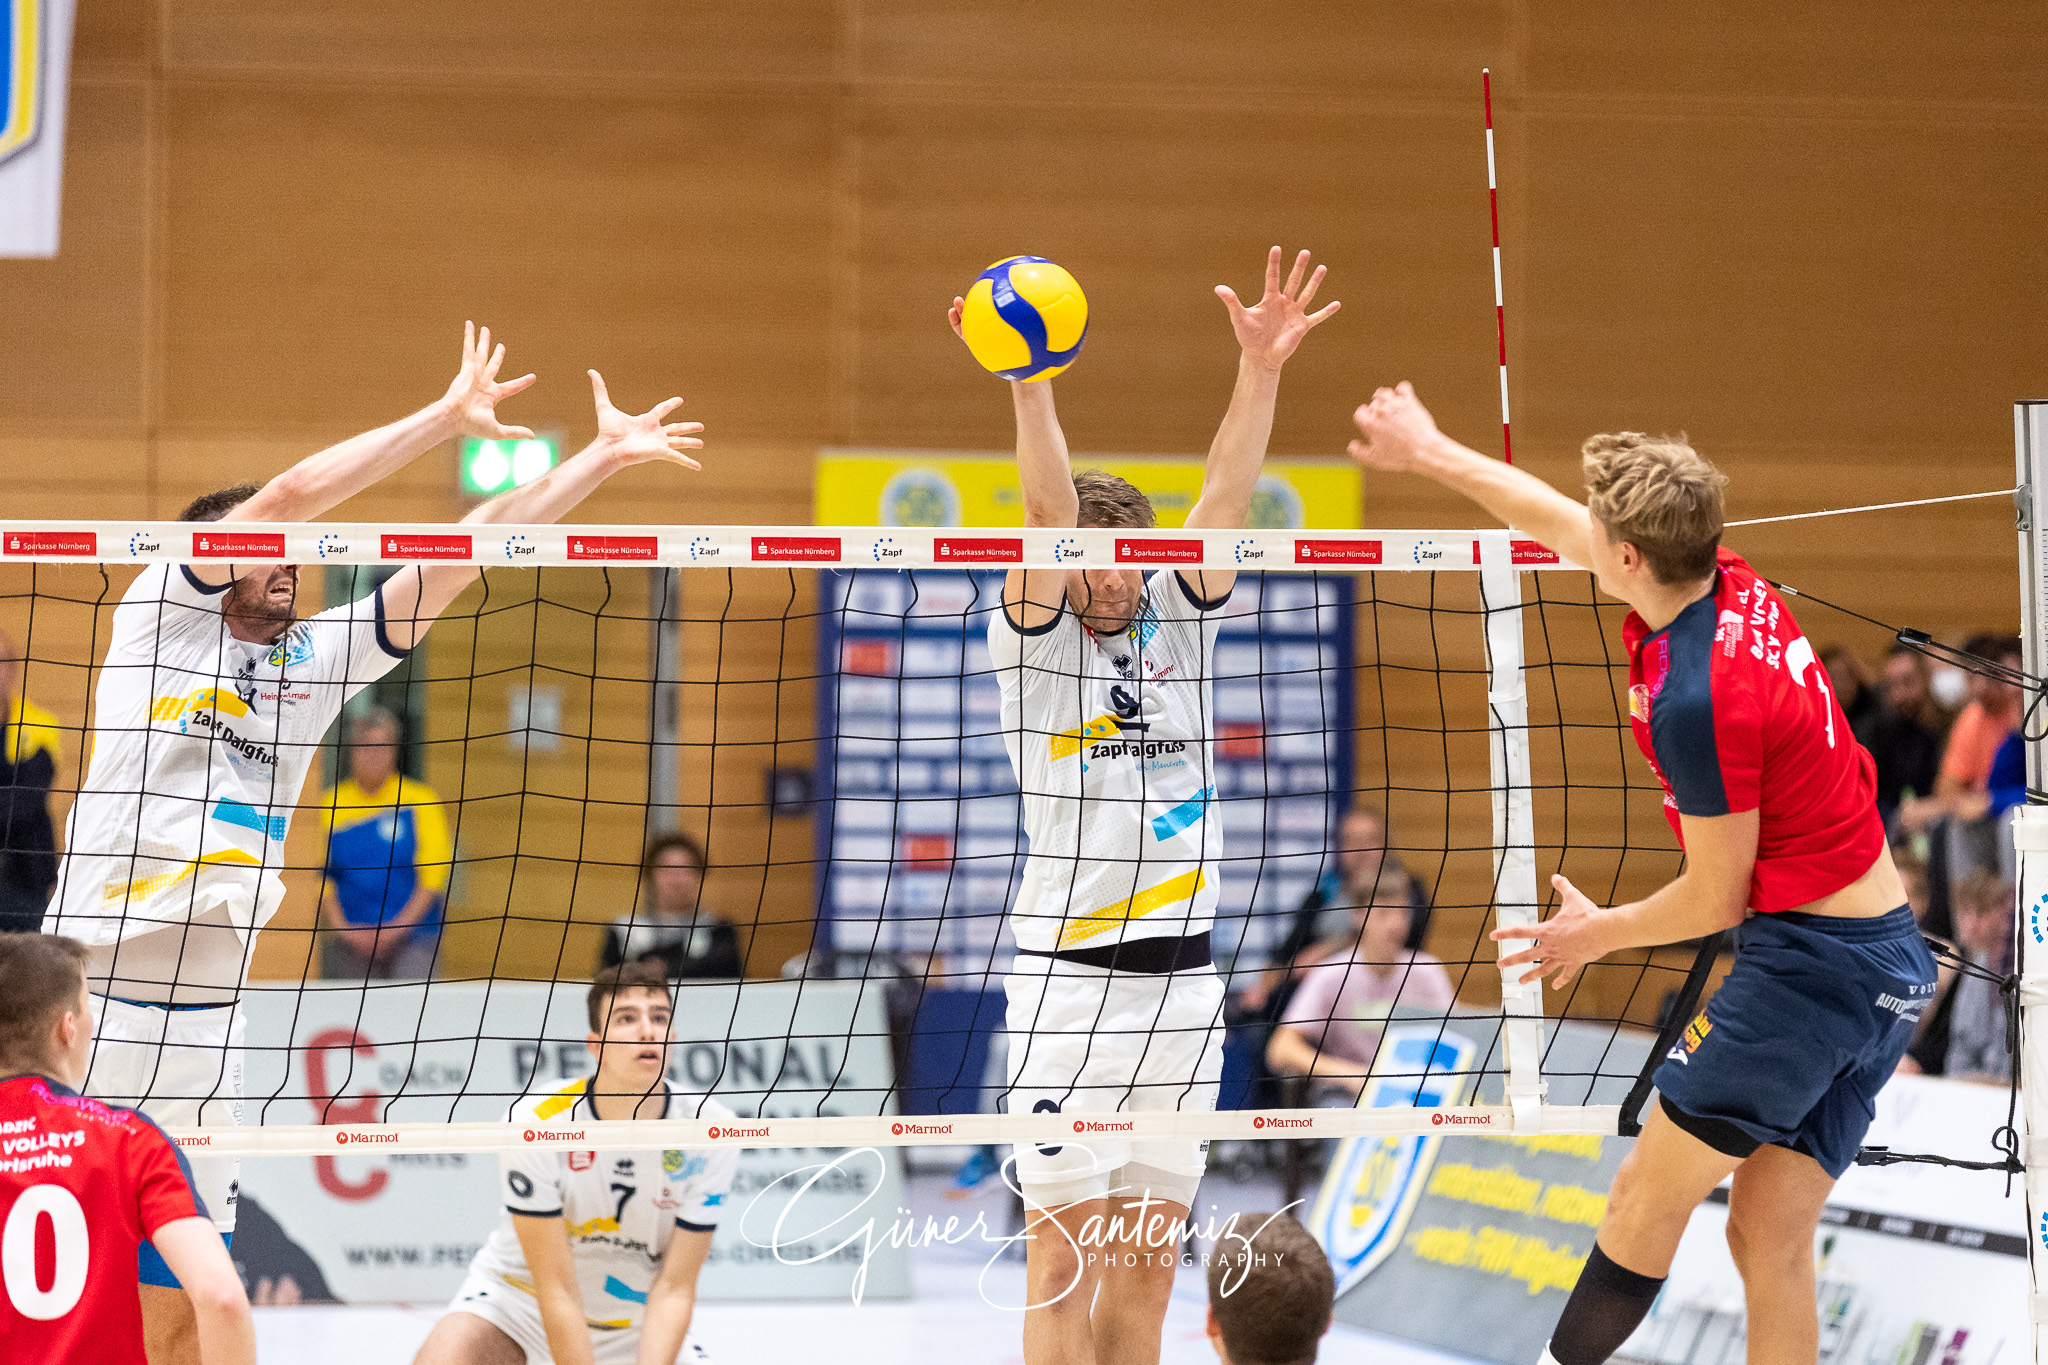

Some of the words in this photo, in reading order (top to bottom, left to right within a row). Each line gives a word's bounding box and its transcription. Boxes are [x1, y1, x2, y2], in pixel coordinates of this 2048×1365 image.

[24, 542, 56, 552] Sparkasse
[58, 542, 90, 552] Nürnberg
[138, 543, 160, 552] Zapf
[212, 543, 246, 553] Sparkasse
[248, 543, 279, 553] Nürnberg
[327, 545, 348, 554] Zapf
[400, 545, 433, 555] Sparkasse
[435, 545, 466, 555] Nürnberg
[514, 546, 535, 555] Zapf
[586, 546, 618, 556] Sparkasse
[620, 546, 651, 556] Nürnberg
[699, 547, 720, 556] Zapf
[771, 547, 803, 557] Sparkasse
[805, 547, 835, 557] Nürnberg
[881, 549, 902, 557] Zapf
[953, 548, 984, 558] Sparkasse
[986, 548, 1016, 558] Nürnberg
[1063, 550, 1084, 558] Zapf
[1134, 549, 1165, 559] Sparkasse
[1167, 549, 1197, 559] Nürnberg
[1243, 550, 1264, 559] Zapf
[1313, 550, 1345, 560] Sparkasse
[1347, 550, 1376, 560] Nürnberg
[1422, 551, 1442, 560] Zapf
[512, 1042, 854, 1088] PEONAL
[1267, 1116, 1314, 1128] Marmot
[1445, 1113, 1491, 1125] Marmot
[905, 1123, 953, 1135] Marmot
[1086, 1120, 1133, 1132] Marmot
[350, 1132, 399, 1143] Marmot
[537, 1130, 585, 1141] Marmot
[722, 1127, 770, 1138] Marmot
[2, 1130, 86, 1155] VOLLEYS
[172, 1135, 211, 1146] armot
[610, 1183, 636, 1224] 7
